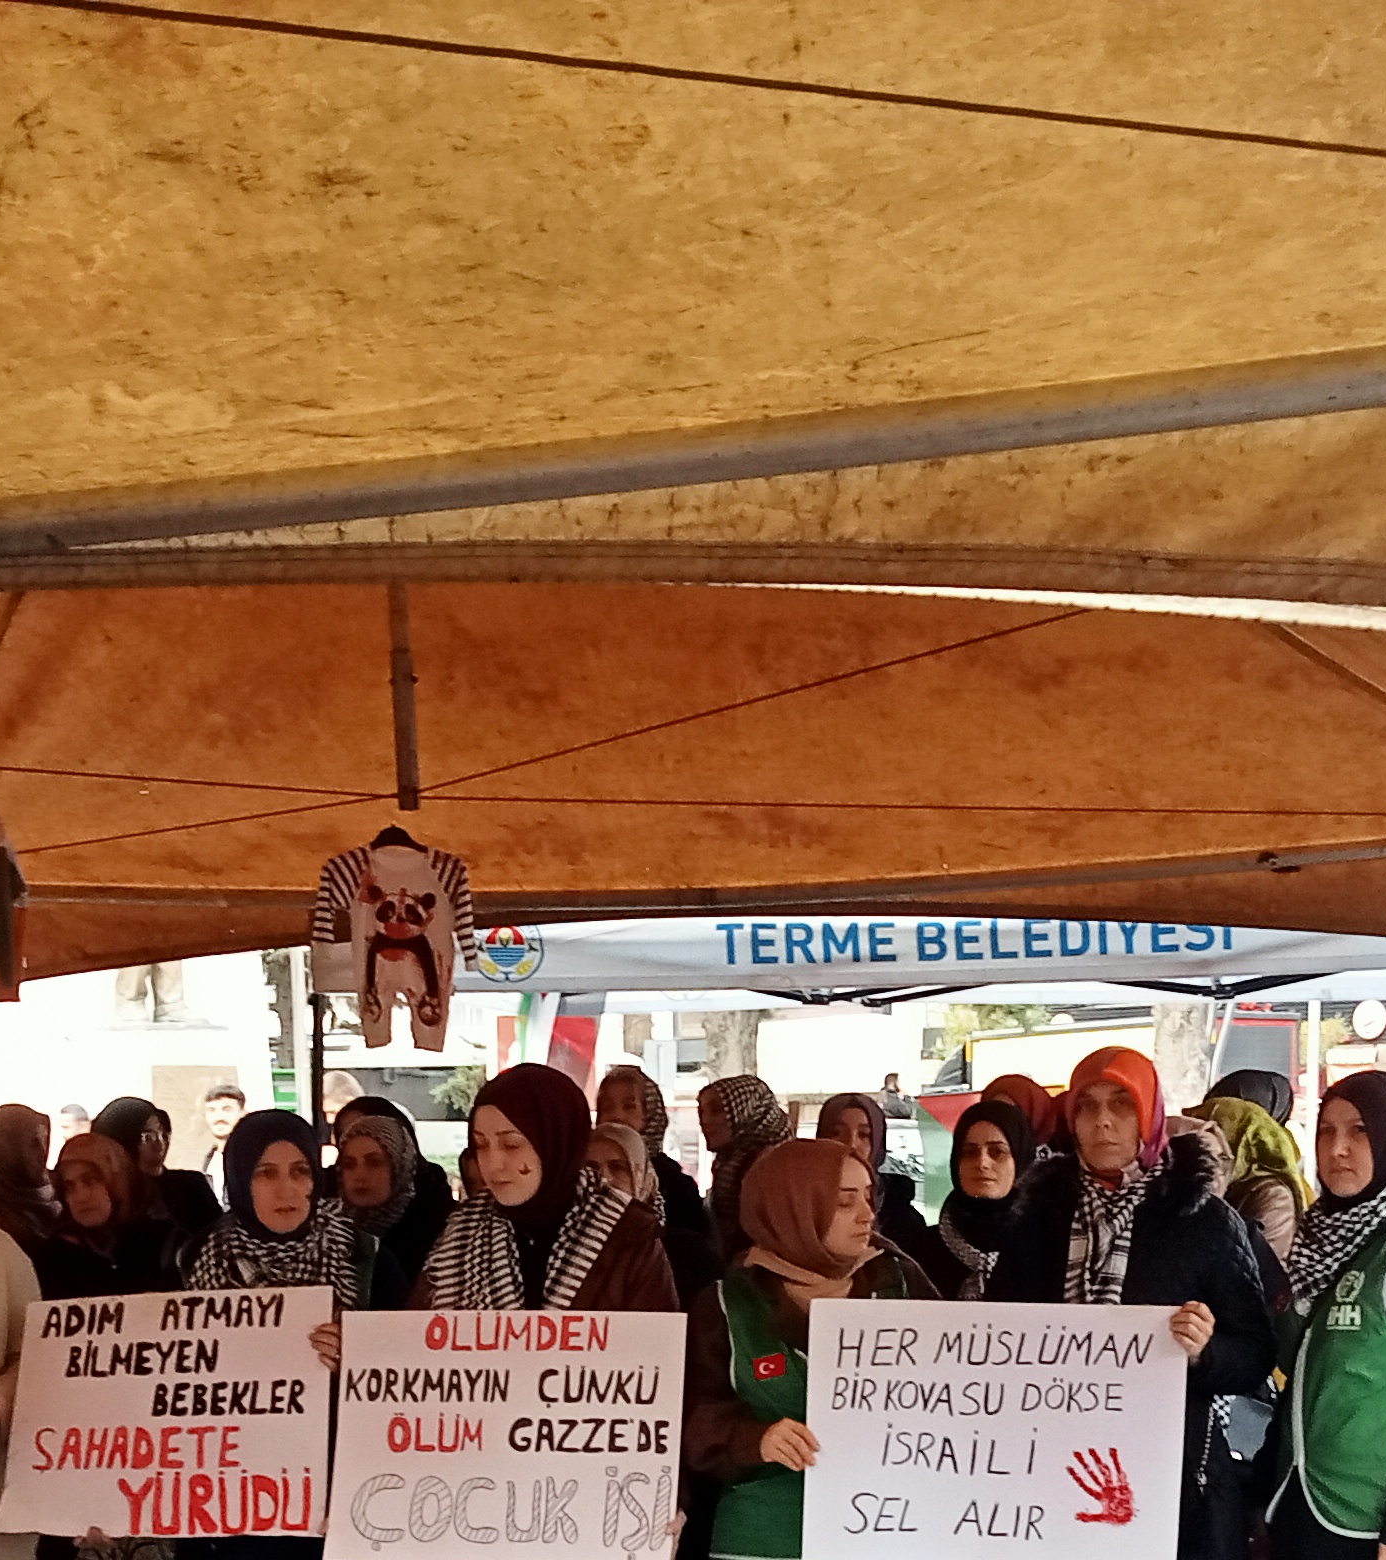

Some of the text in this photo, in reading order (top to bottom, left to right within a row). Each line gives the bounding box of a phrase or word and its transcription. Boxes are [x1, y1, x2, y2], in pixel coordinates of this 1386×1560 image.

[716, 922, 897, 965] TERME
[41, 1293, 285, 1338] ADIM ATMAYI
[425, 1311, 610, 1351] ÖLÜMDEN
[65, 1339, 219, 1378] BİLMEYEN
[836, 1323, 1155, 1369] HER MÜSLÜMAN
[151, 1379, 306, 1417] BEBEKLER
[344, 1365, 660, 1408] KORKMAYIN ÇÜNKÜ
[830, 1372, 877, 1412] BİR
[1020, 1376, 1124, 1413] DÖKSE
[387, 1411, 483, 1453] ÖLÜM
[117, 1467, 312, 1535] YÜRÜDÜ
[350, 1473, 579, 1552] ÇOCUK
[843, 1492, 1045, 1541] SEL ALIR
